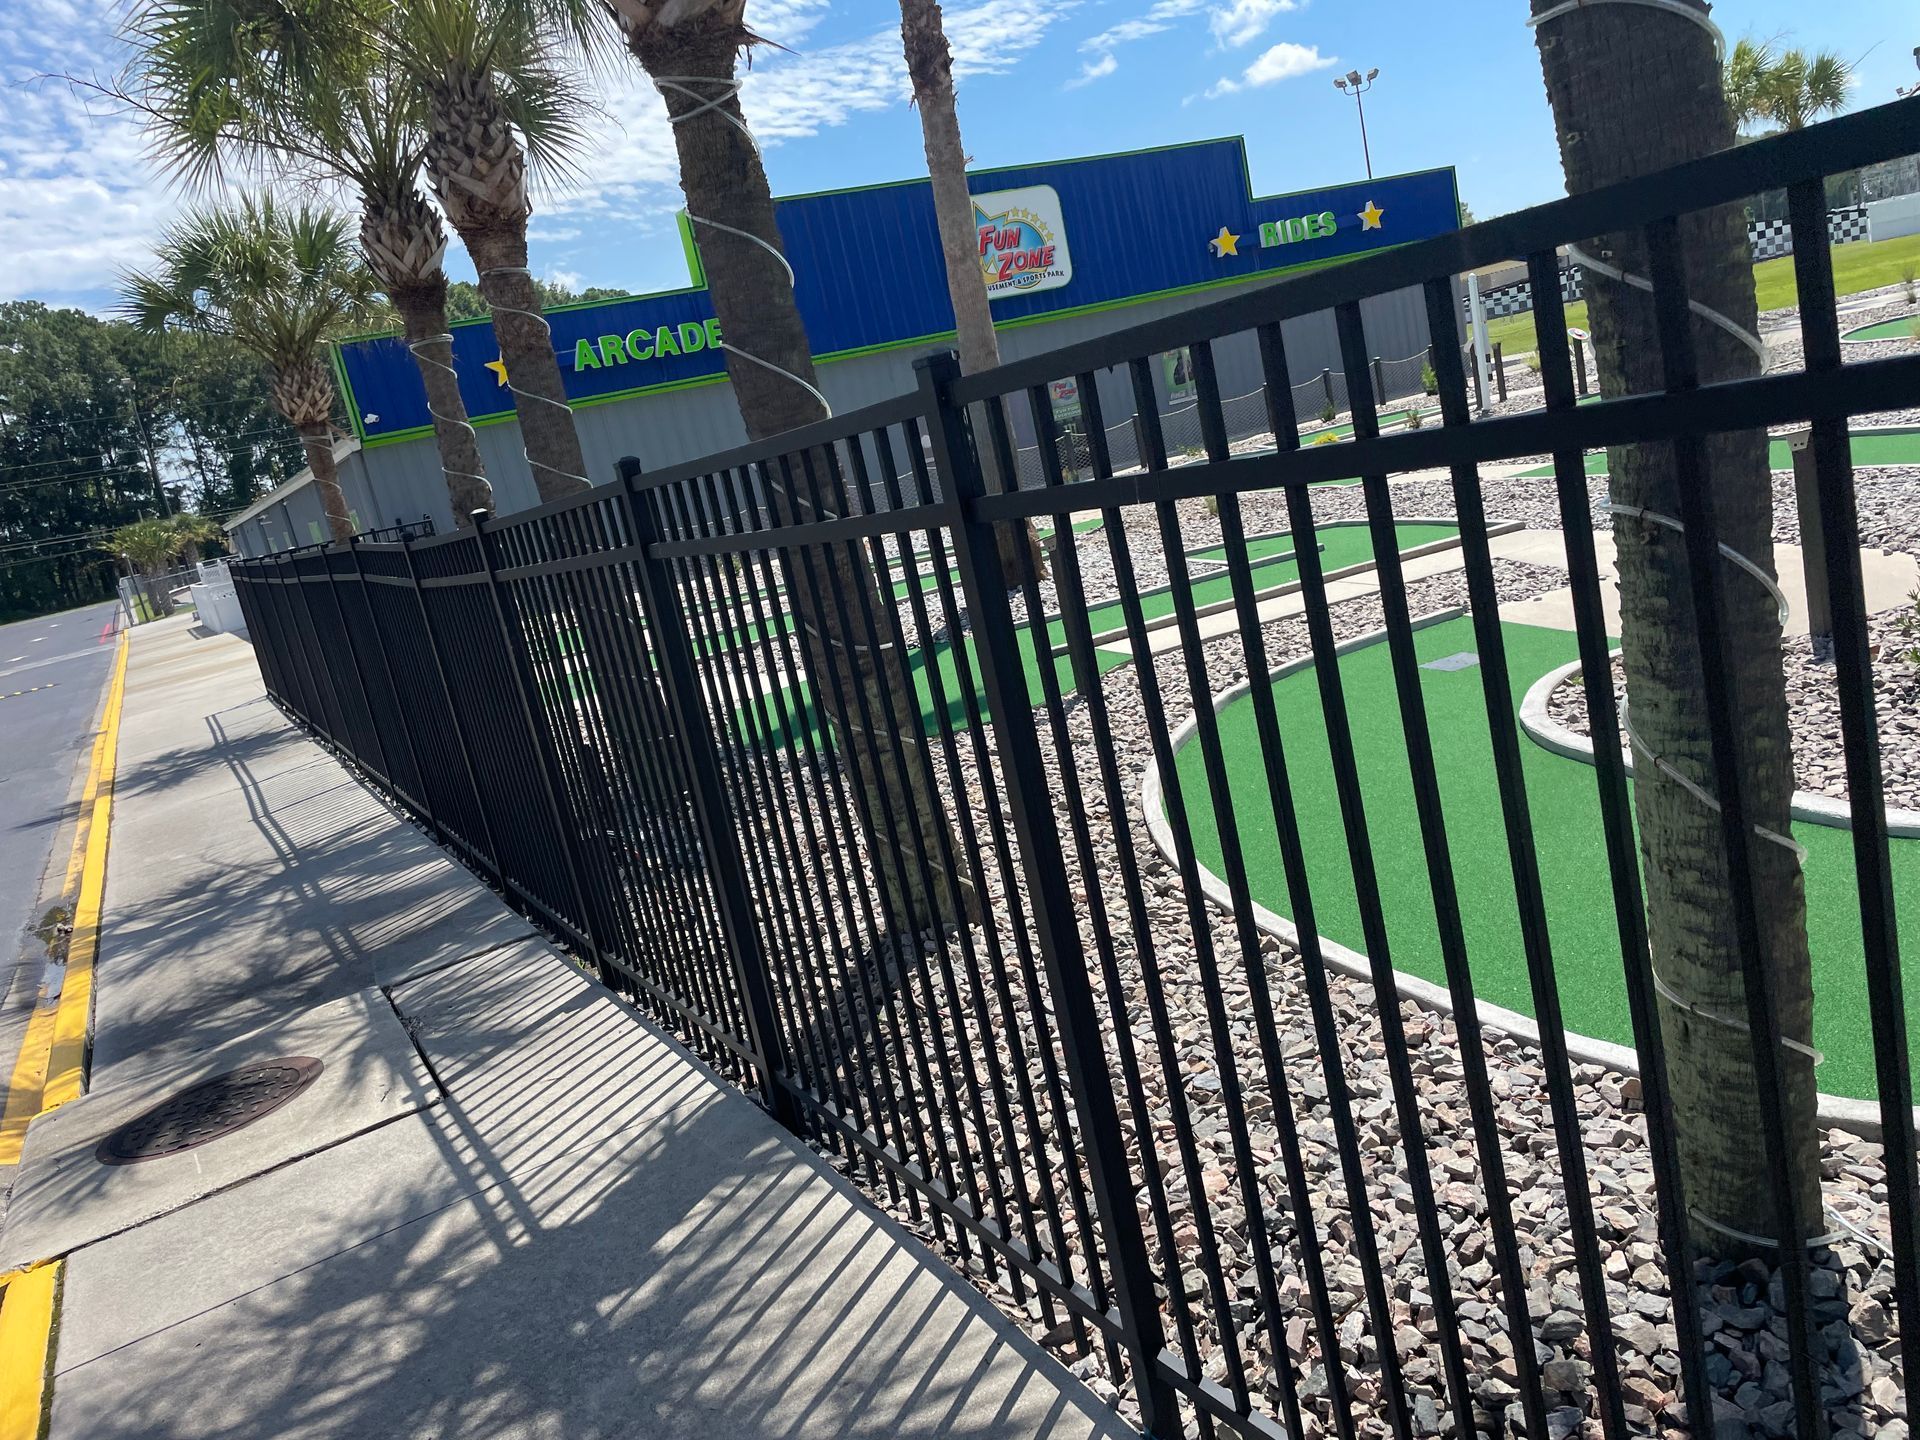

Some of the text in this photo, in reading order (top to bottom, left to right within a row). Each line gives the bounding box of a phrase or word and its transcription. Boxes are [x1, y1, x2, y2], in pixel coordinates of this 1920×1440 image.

[979, 225, 1021, 256] FUN
[1258, 211, 1337, 248] RIDES
[988, 280, 1016, 291] USEMENT
[1023, 272, 1046, 282] SPORTS
[998, 245, 1055, 282] ZONE
[574, 317, 722, 371] ARCADE
